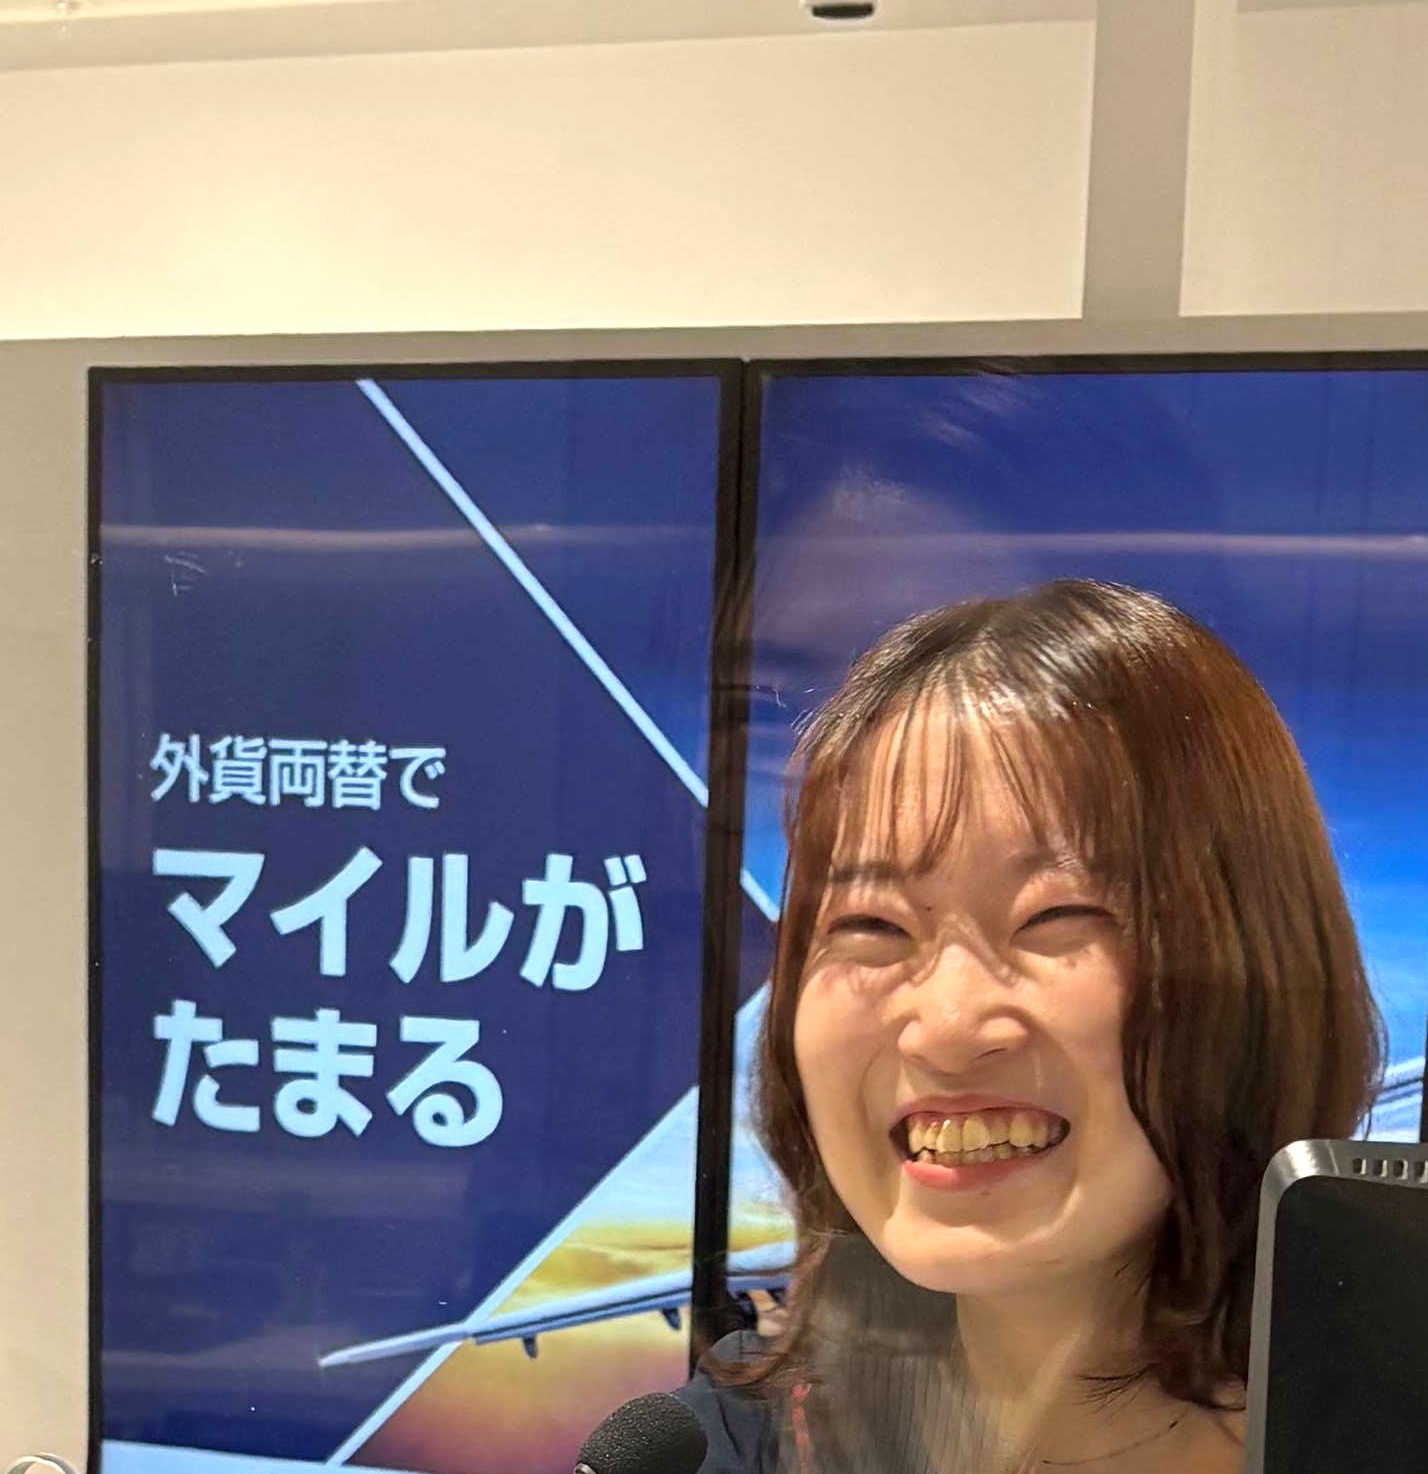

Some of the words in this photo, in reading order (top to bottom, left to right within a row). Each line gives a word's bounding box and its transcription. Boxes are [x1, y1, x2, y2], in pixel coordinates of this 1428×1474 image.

[151, 733, 446, 810] 外貨両替で
[152, 846, 648, 991] マイルが
[152, 999, 504, 1147] たまる
